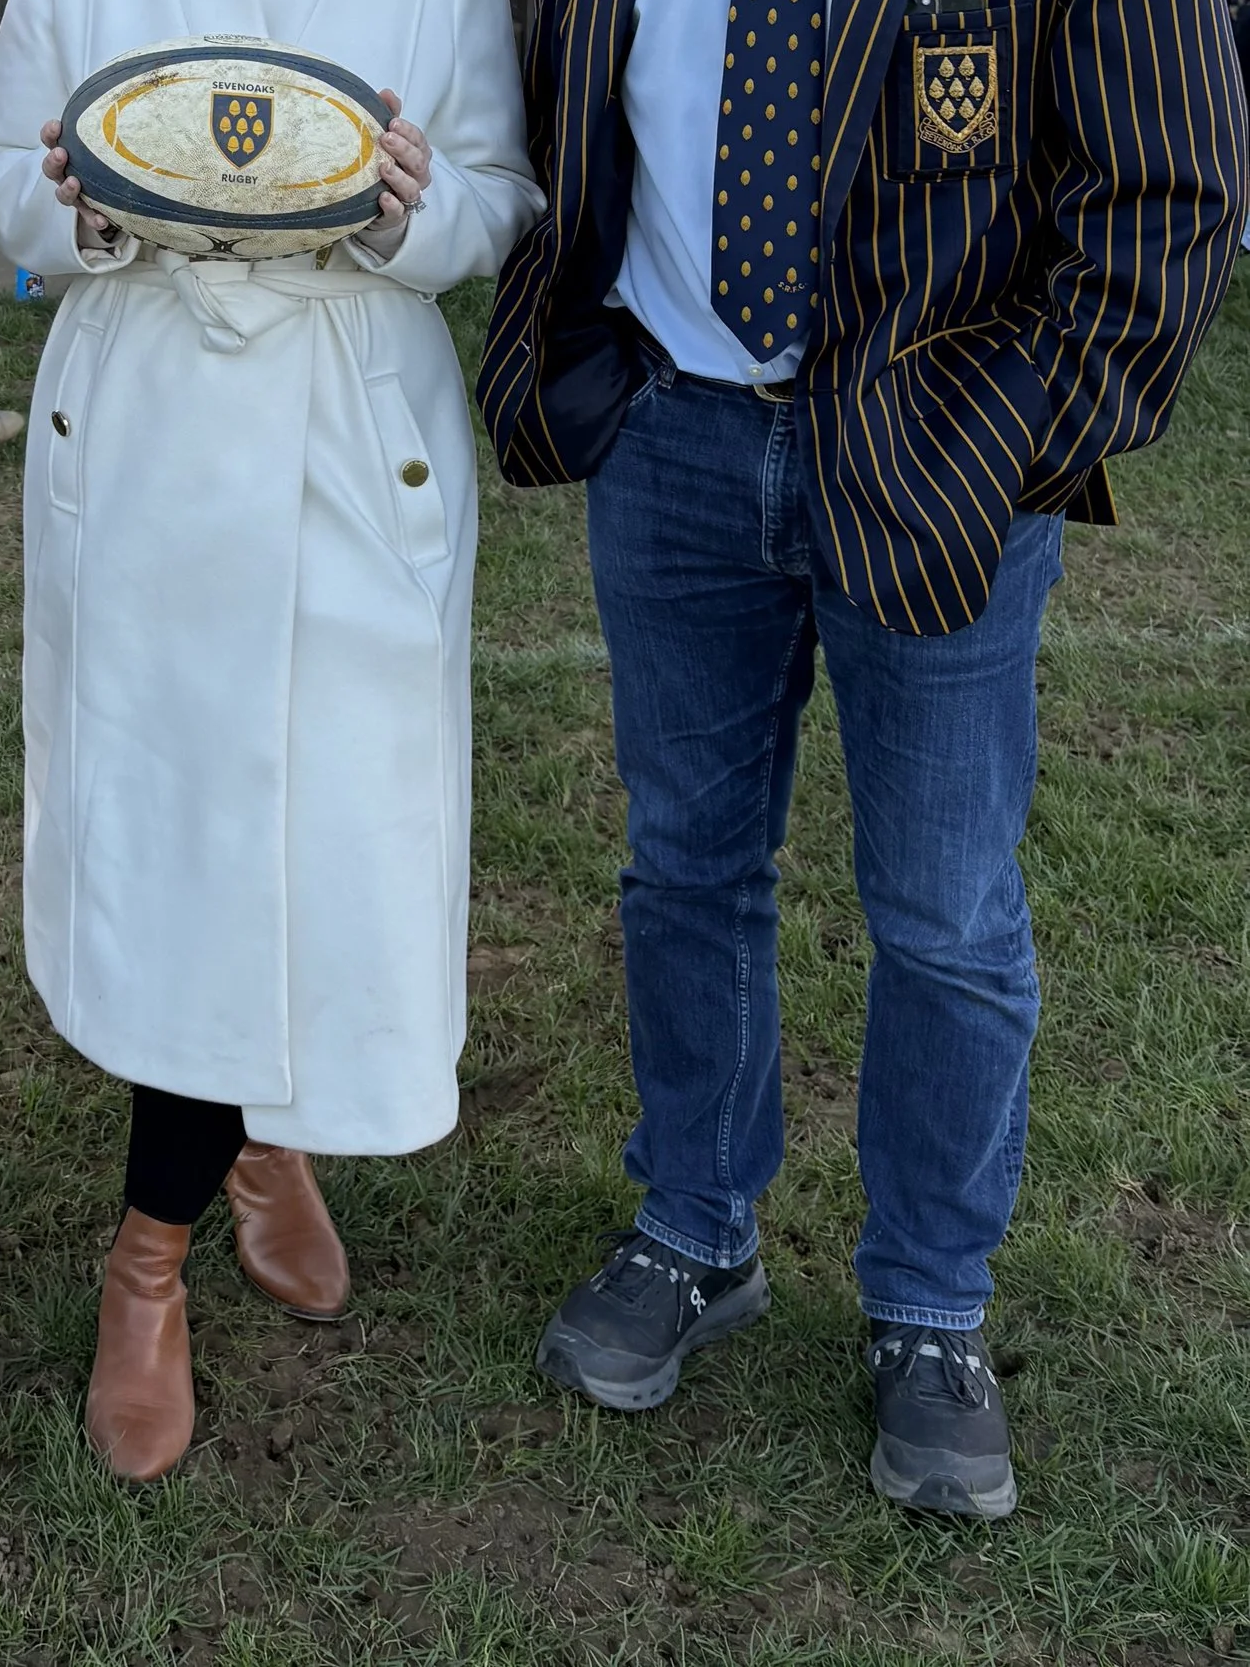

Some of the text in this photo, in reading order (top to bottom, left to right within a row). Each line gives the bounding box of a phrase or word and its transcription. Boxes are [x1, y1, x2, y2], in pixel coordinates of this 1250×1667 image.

[212, 80, 275, 94] SEVENOAKS
[922, 130, 970, 152] SEVENOAKS
[221, 172, 259, 186] RUGBY
